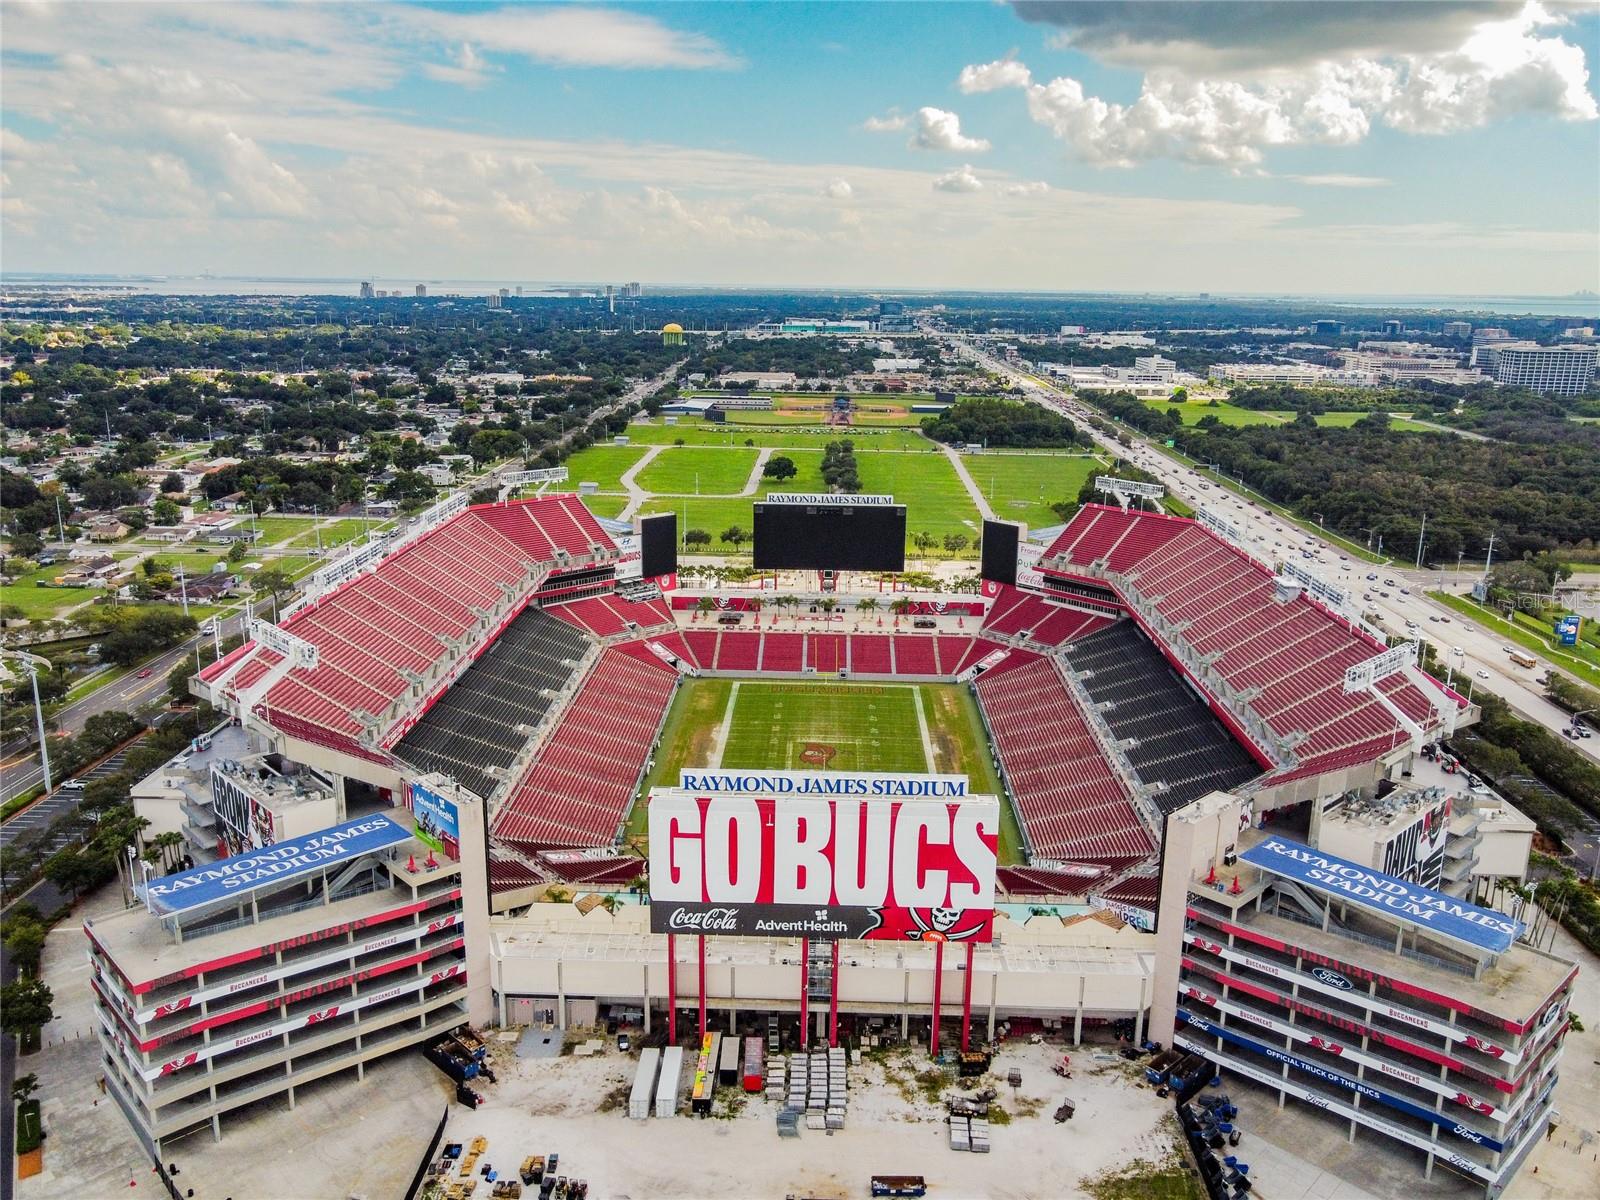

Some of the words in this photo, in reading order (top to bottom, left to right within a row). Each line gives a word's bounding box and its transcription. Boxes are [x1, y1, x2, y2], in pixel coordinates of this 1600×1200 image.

[768, 495, 816, 503] RAYMOND
[818, 495, 849, 504] JAMES
[851, 496, 892, 504] STADIUM
[682, 775, 793, 793] RAYMOND
[796, 778, 867, 795] JAMES
[872, 780, 966, 797] STADIUM
[149, 846, 300, 897] RAYMOND
[304, 819, 391, 851] JAMES
[648, 798, 762, 904] GO
[773, 800, 999, 909] BUCS
[222, 844, 350, 889] STADIUM
[1262, 841, 1410, 896] RAYMOND
[1411, 889, 1517, 934] JAMES
[1305, 869, 1439, 921] STADIUM
[669, 907, 739, 930] Coca-Cola
[364, 936, 397, 952] BUCCANEERS
[1245, 958, 1279, 976] BUCCANEERS
[230, 974, 268, 992] BUCCANEERS
[1319, 971, 1344, 988] Ford
[368, 988, 401, 1004] BUCCANEERS
[1187, 1015, 1209, 1031] Ford
[1239, 1010, 1273, 1028] BUCCANEERS
[1388, 1008, 1429, 1028] BUCCANEERS
[235, 1029, 273, 1047] BUCCANEERS
[1185, 1041, 1206, 1056] Ford
[1266, 1049, 1300, 1067] OFFICIAL
[1300, 1062, 1327, 1078] TRUCK
[1327, 1072, 1340, 1081] OF
[1341, 1077, 1356, 1090] THE
[1357, 1084, 1381, 1099] BUCS
[1381, 1064, 1421, 1085] BUCCANEERS
[1306, 1091, 1330, 1109] Ford
[1453, 1124, 1482, 1145] Ford
[1449, 1153, 1478, 1172] Ford
